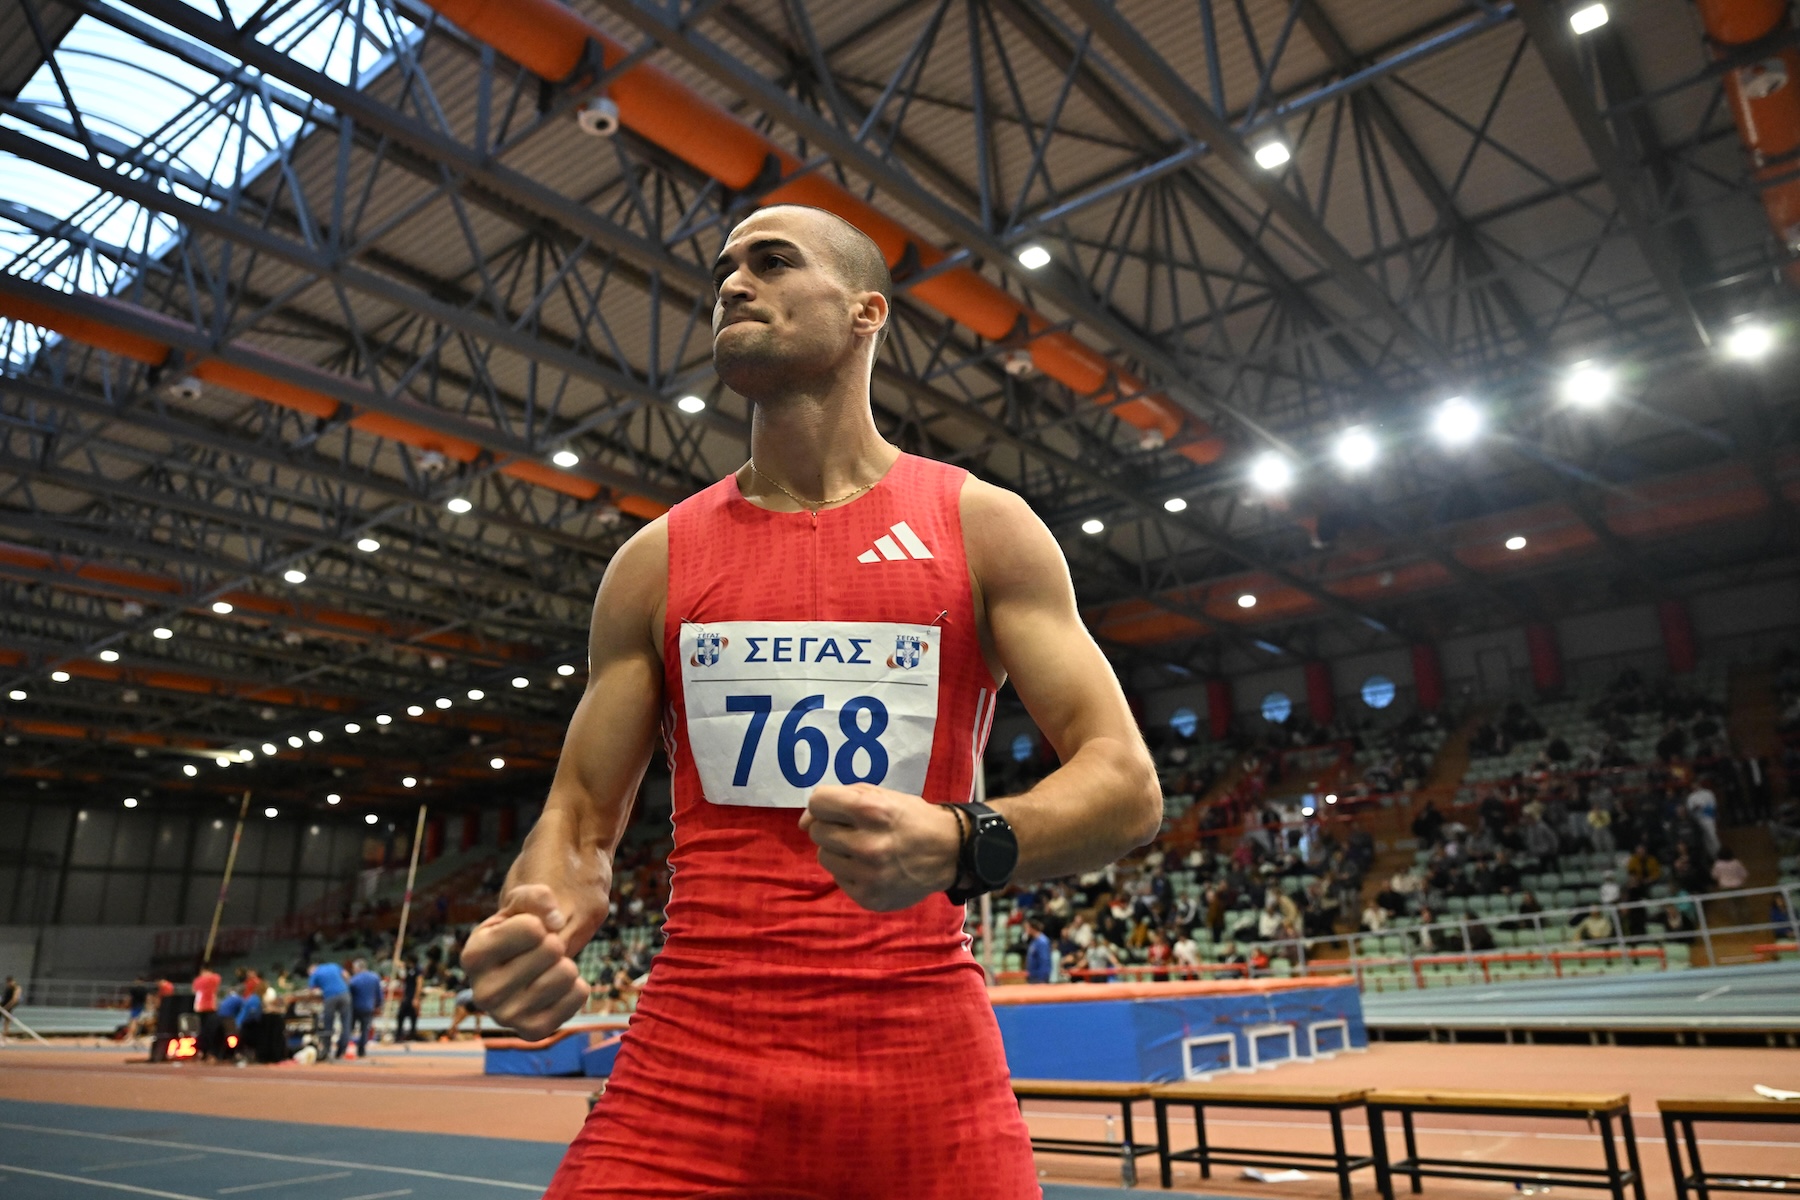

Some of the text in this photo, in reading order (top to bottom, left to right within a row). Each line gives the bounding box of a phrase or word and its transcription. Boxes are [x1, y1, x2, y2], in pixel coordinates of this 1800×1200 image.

[744, 637, 872, 665] ΣΕΓΑΣ
[896, 634, 920, 642] ΣΕΓΑΣ
[726, 694, 889, 788] 768
